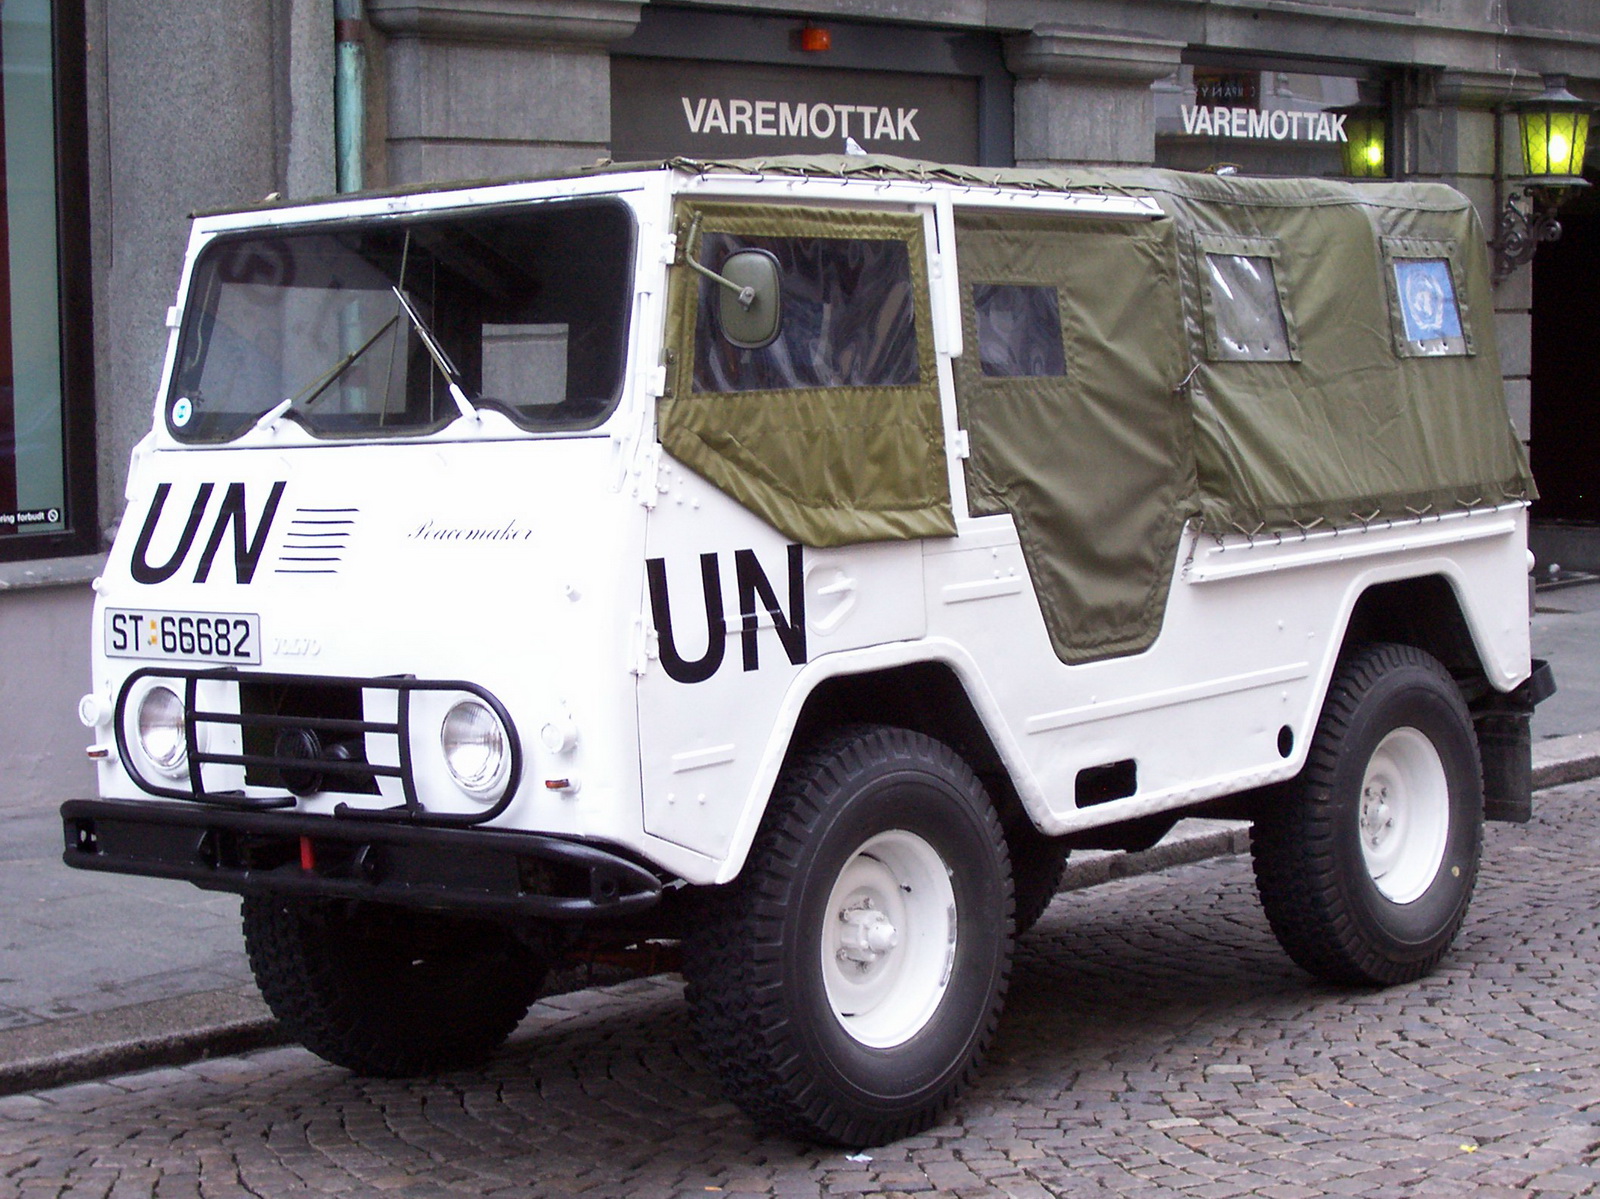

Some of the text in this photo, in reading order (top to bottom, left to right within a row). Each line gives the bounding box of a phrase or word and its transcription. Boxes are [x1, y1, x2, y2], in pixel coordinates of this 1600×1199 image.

[682, 97, 920, 141] VAREMOTTAK
[1181, 104, 1348, 142] VAREMOTTAK
[131, 481, 287, 584] UN
[408, 519, 532, 540] Peacemaker
[112, 614, 250, 657] ST 66682
[646, 544, 807, 684] UN
[271, 637, 322, 656] VOLVO
